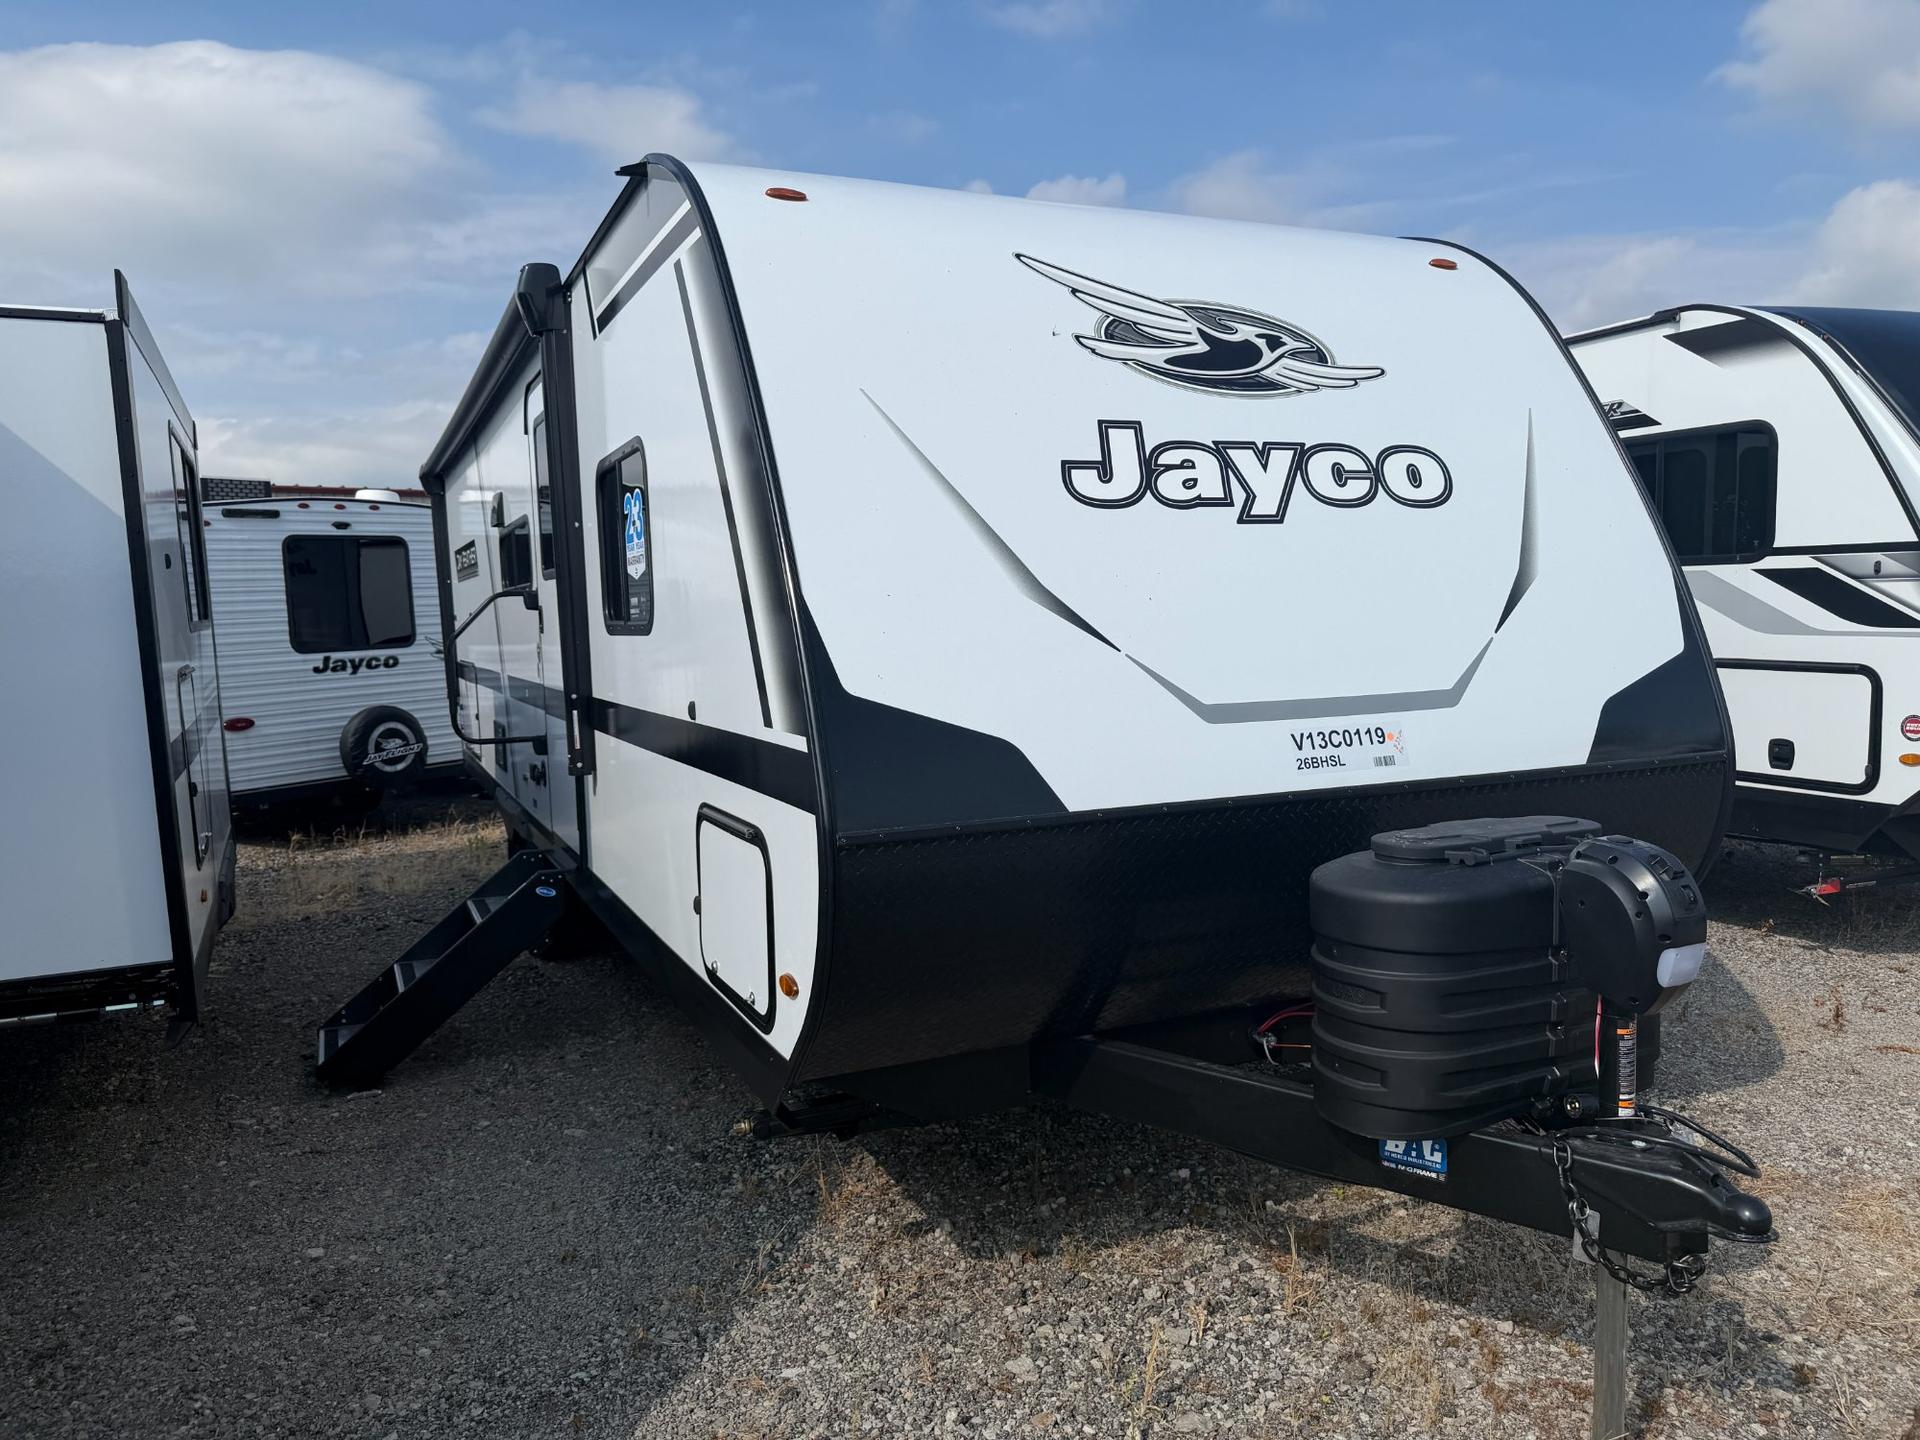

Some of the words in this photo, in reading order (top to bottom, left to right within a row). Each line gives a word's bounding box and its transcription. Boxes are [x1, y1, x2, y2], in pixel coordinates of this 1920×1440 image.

[1061, 419, 1453, 524] Jayco
[312, 655, 399, 675] Jayco
[1291, 727, 1386, 751] V13C0119
[1296, 755, 1346, 770] 26BHSL
